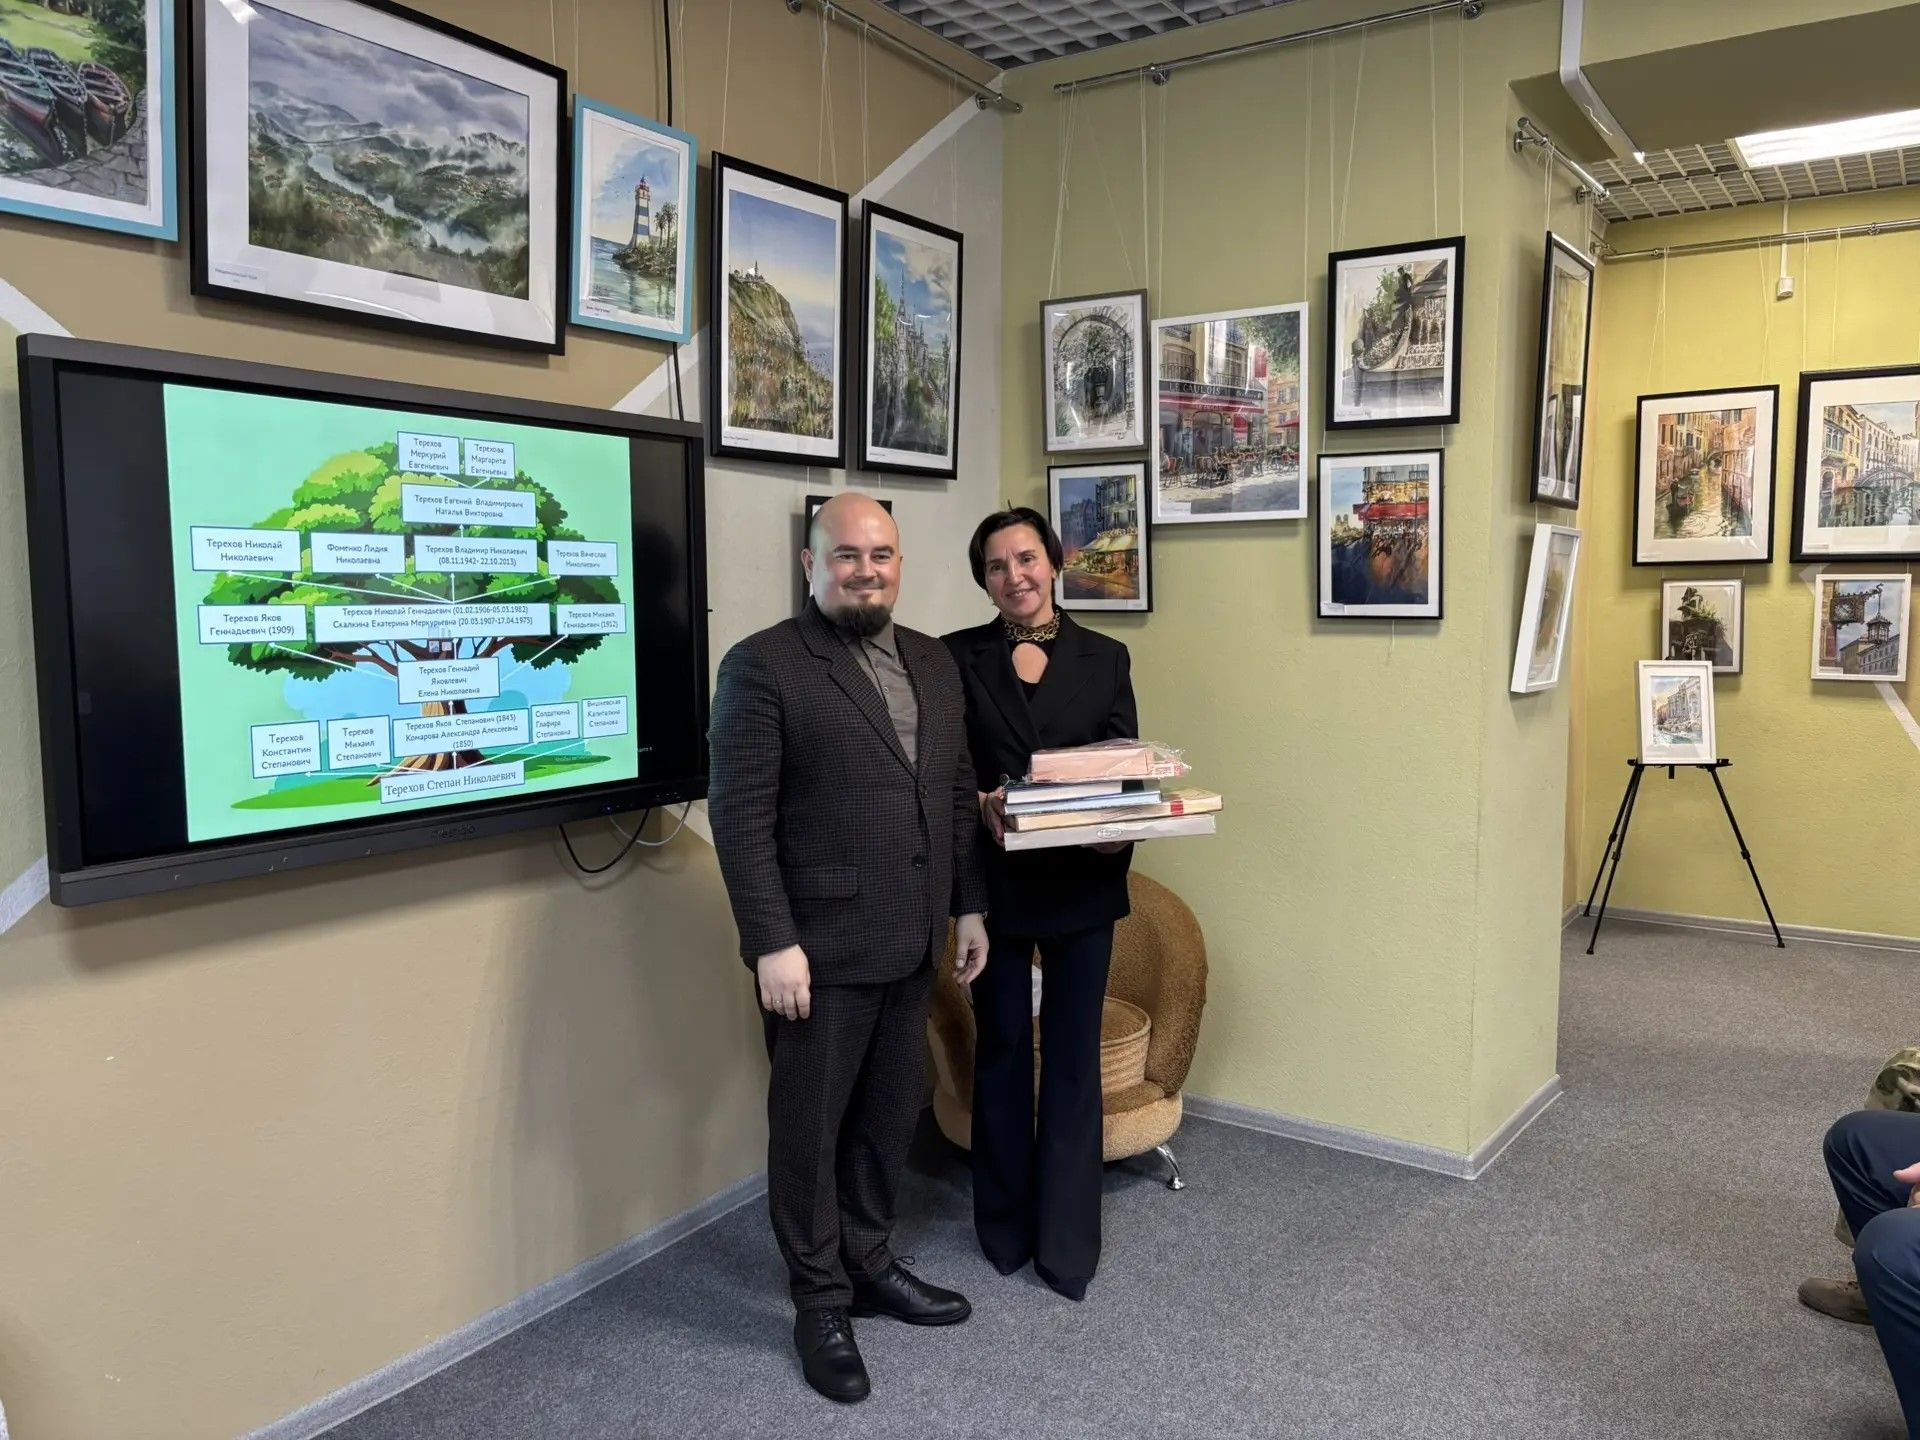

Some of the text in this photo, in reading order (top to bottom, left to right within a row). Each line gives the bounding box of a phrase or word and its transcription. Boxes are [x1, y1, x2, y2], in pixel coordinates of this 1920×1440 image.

[413, 438, 442, 448] Терехов
[475, 443, 504, 454] Терехова
[410, 449, 447, 461] Меркурий
[471, 455, 507, 466] Маргарита
[408, 461, 449, 471] Евгеньевич
[470, 466, 508, 476] Евгеньевна
[415, 494, 524, 509] Терехов Евгений Владимирович
[435, 507, 504, 519] Наталья Викторовна
[206, 538, 283, 550] Терехов Николай
[326, 543, 388, 553] Фоменко Лидия
[426, 545, 528, 556] Терехов Владимир Николаевич
[556, 550, 579, 559] Терехов
[220, 552, 274, 562] Николаевич
[336, 555, 381, 565] Николаевна
[342, 608, 373, 618] Терехов
[374, 606, 405, 616] Николай
[407, 606, 451, 616] Геннадьевич
[569, 610, 592, 619] Терехов
[223, 613, 282, 624] Терехов Яков
[332, 620, 369, 629] Скалкина
[371, 619, 409, 629] Екатерина
[410, 618, 457, 628] Меркурьевна
[210, 625, 295, 637] Геннадьевич (1909)
[419, 664, 480, 676] Терехов Геннадий
[431, 677, 467, 685] Яковлевич
[418, 687, 480, 698] Елена Николаевна
[535, 709, 571, 718] Солдаткина
[406, 721, 434, 732] Терехов
[435, 720, 451, 729] Яков
[455, 715, 495, 726] Степанович
[536, 720, 561, 729] Глафира
[342, 727, 374, 737] Терехов
[405, 725, 518, 743] Комарова Александра Алексеевна
[536, 730, 571, 739] Степановна
[269, 732, 304, 744] Терехов
[344, 740, 375, 749] Михаил
[453, 740, 474, 749] (1850)
[262, 745, 312, 757] Константин
[336, 751, 382, 762] Степанович
[261, 758, 311, 770] Степанович
[385, 771, 517, 797] Терехов Степан Николаевич
